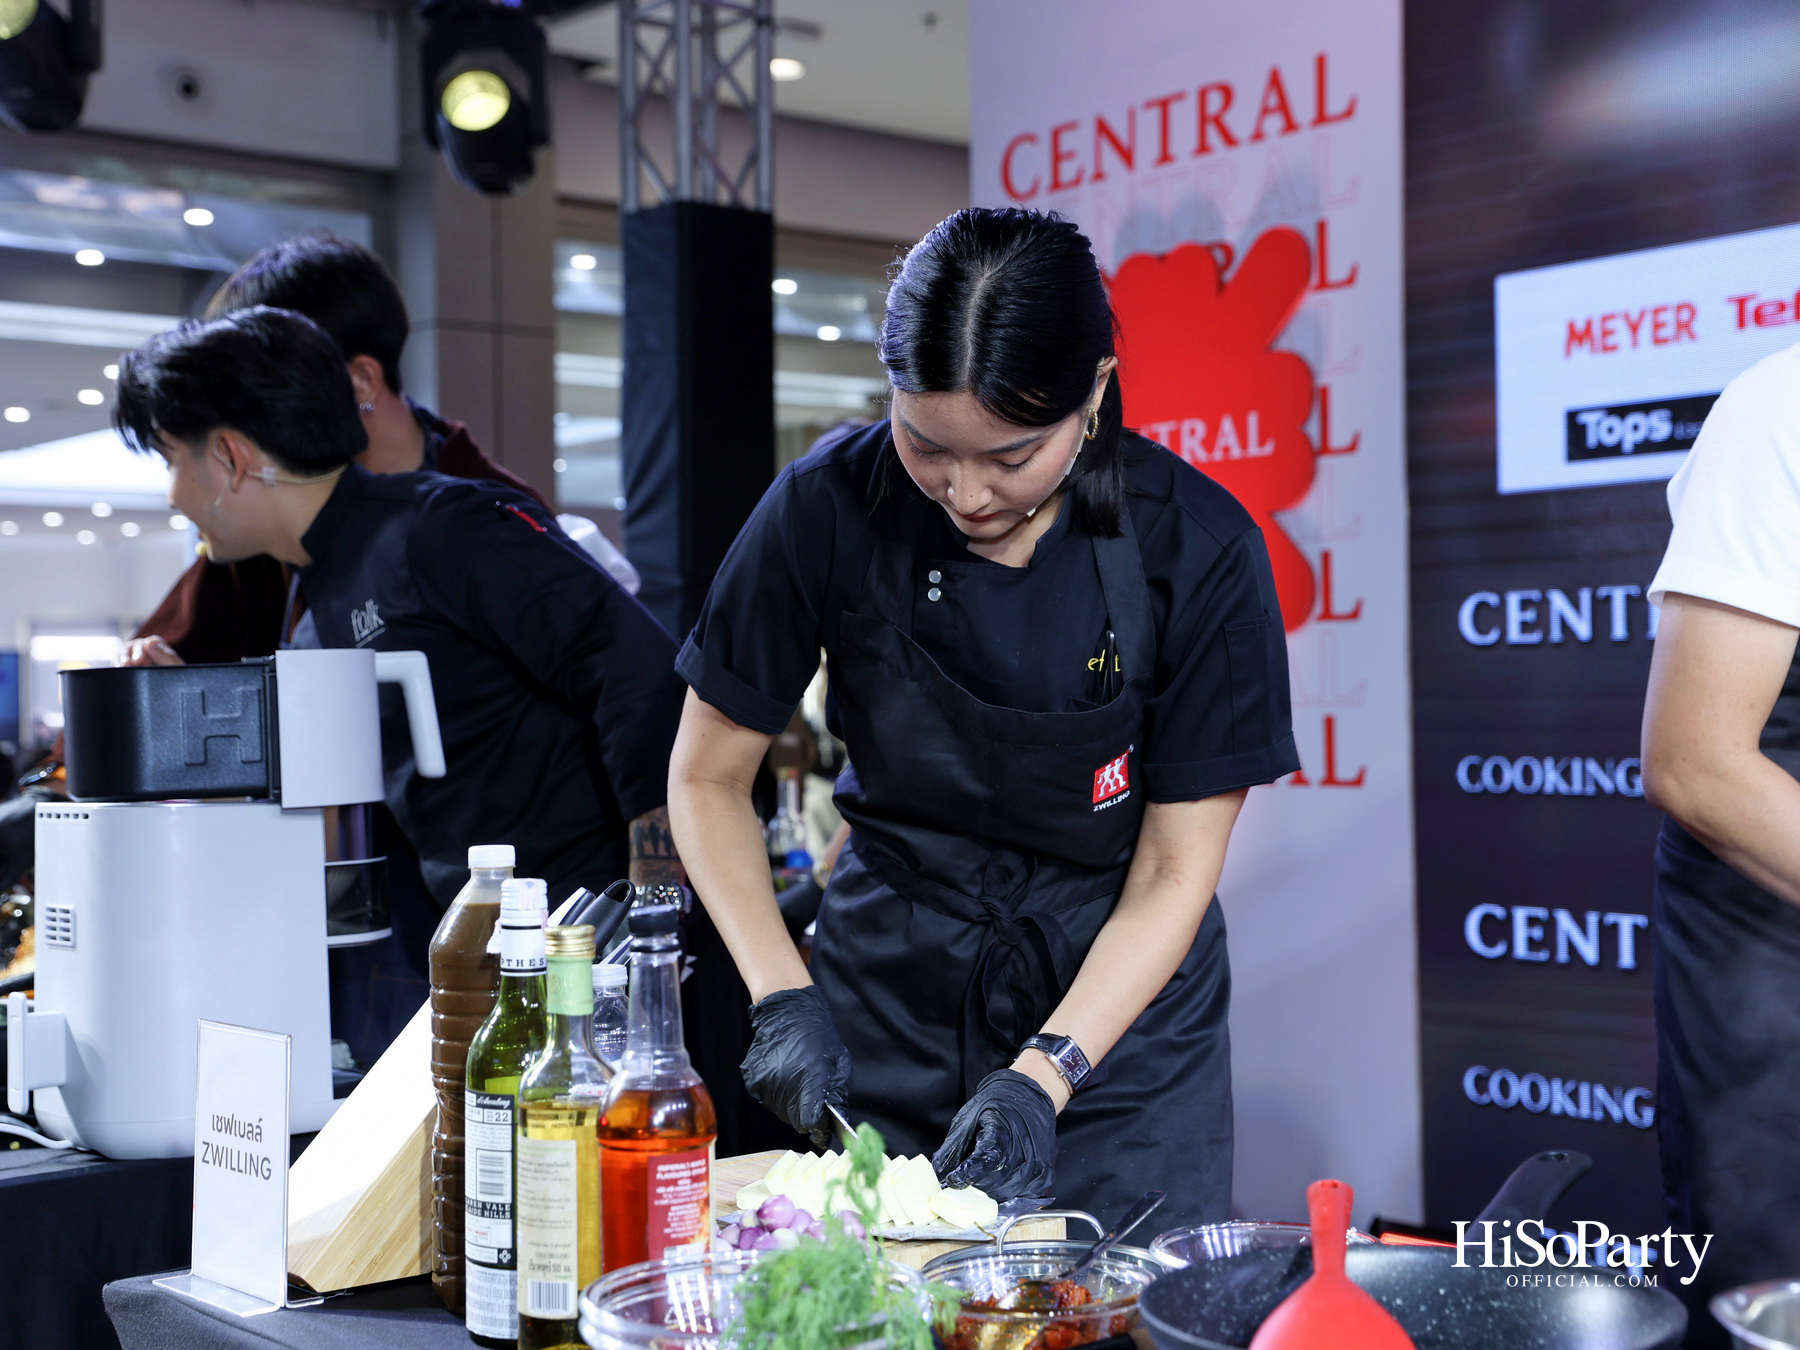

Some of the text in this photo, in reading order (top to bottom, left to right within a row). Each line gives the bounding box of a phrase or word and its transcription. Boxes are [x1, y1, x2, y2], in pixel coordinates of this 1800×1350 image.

[1000, 51, 1359, 202] CENTRAL
[1564, 302, 1697, 358] MEYER
[1140, 409, 1277, 464] TRAL
[1575, 408, 1674, 455] Tops
[1456, 755, 1644, 798] COOKING
[1093, 790, 1131, 812] ZWILLING
[1463, 902, 1650, 971] CENT
[494, 1111, 509, 1122] 22
[1462, 1064, 1657, 1130] COOKING
[212, 1113, 263, 1144] เชฟเบลล์
[202, 1140, 272, 1181] ZWILLING
